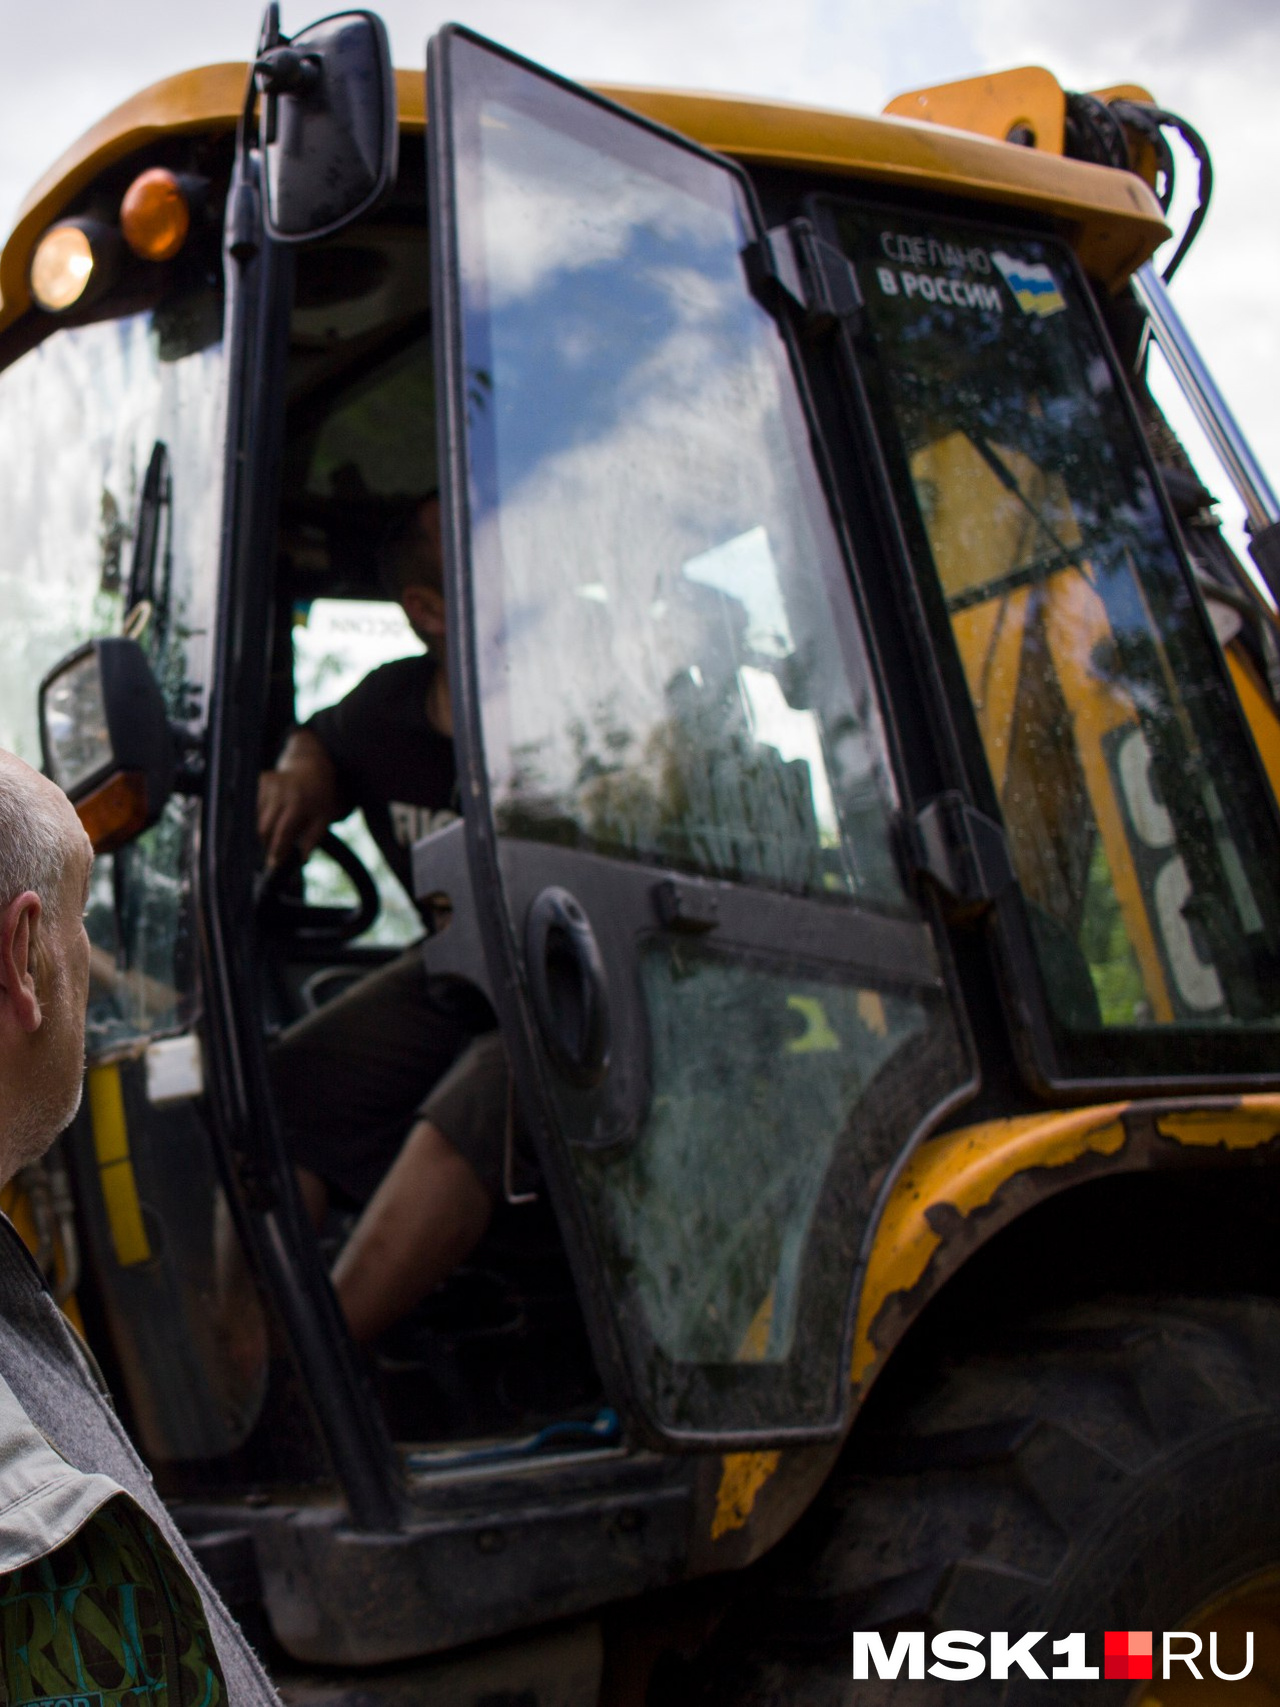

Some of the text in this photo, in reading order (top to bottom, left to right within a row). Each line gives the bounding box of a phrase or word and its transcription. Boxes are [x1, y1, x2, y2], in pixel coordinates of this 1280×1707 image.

[880, 231, 992, 275] СДЕЛАНО
[876, 267, 1004, 314] В РОССИИ
